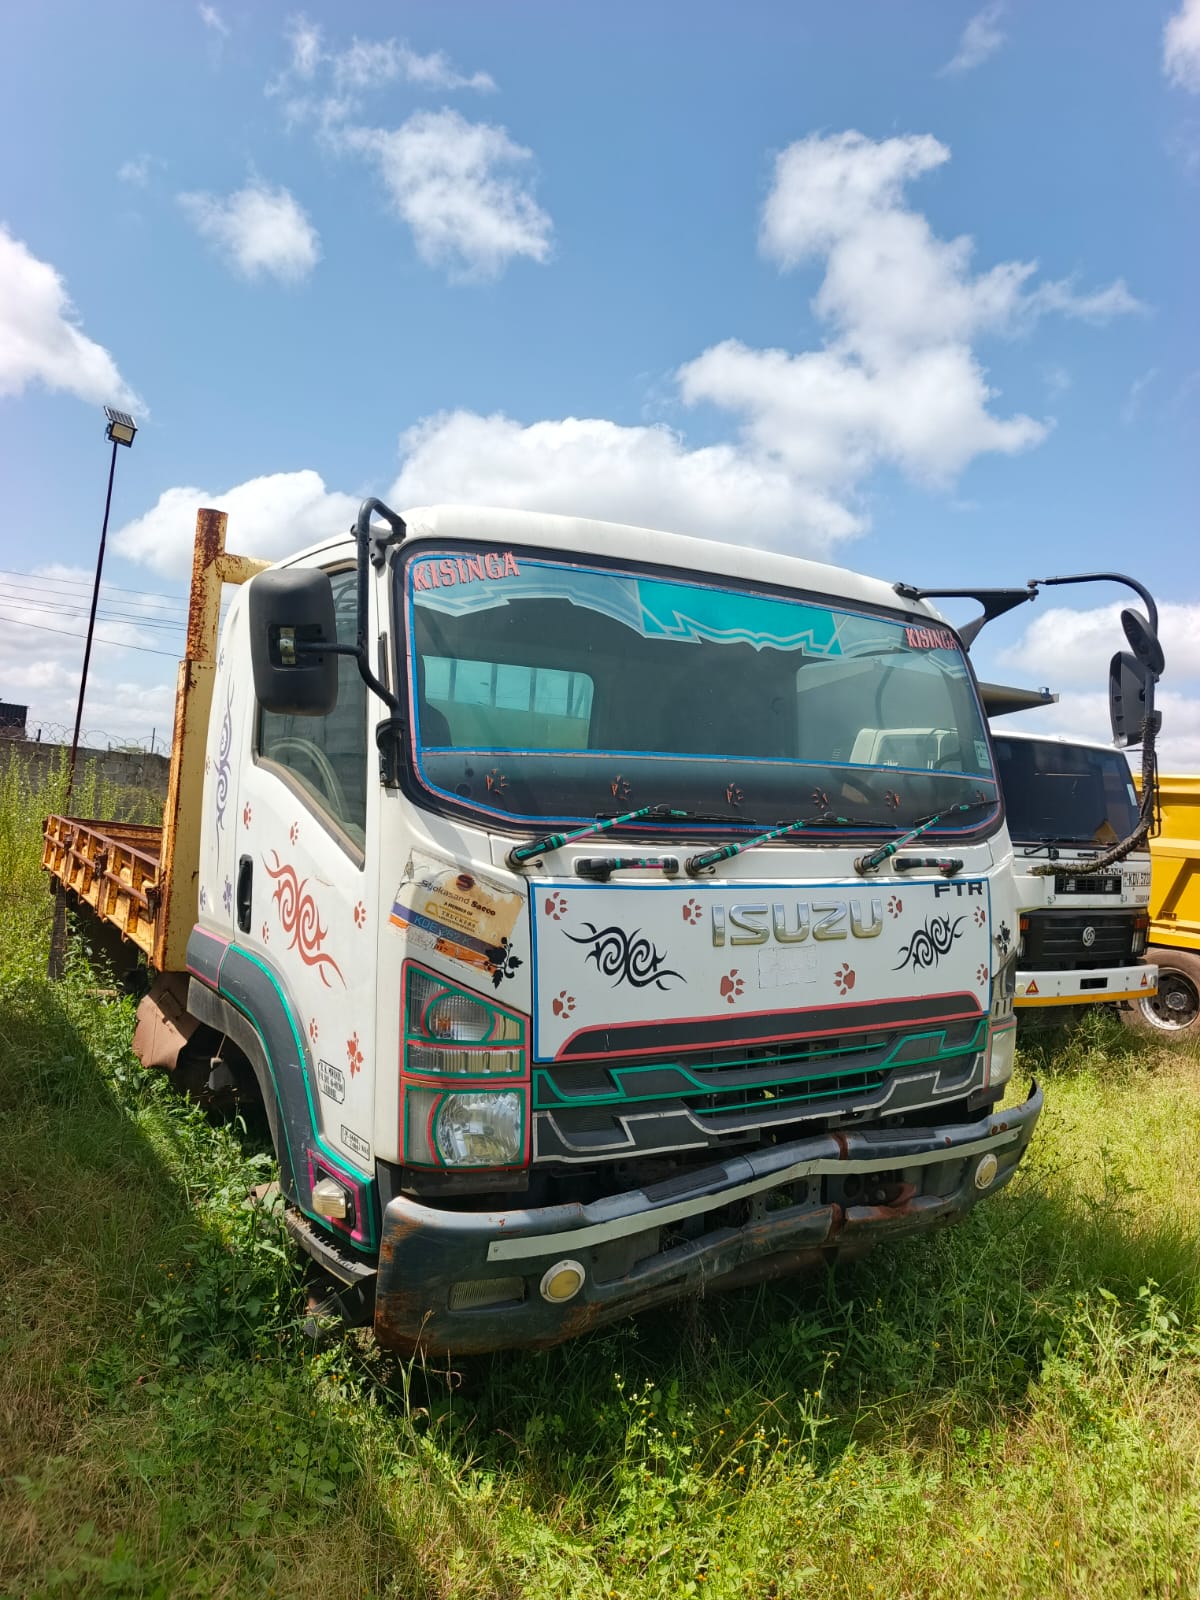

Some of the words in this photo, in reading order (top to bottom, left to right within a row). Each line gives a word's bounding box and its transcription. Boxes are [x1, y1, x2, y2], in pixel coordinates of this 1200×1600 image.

[413, 551, 520, 592] KISINGA
[905, 628, 958, 650] KISINGA
[933, 882, 984, 898] FTR
[470, 900, 496, 916] Sacco
[711, 898, 884, 947] ISUZU
